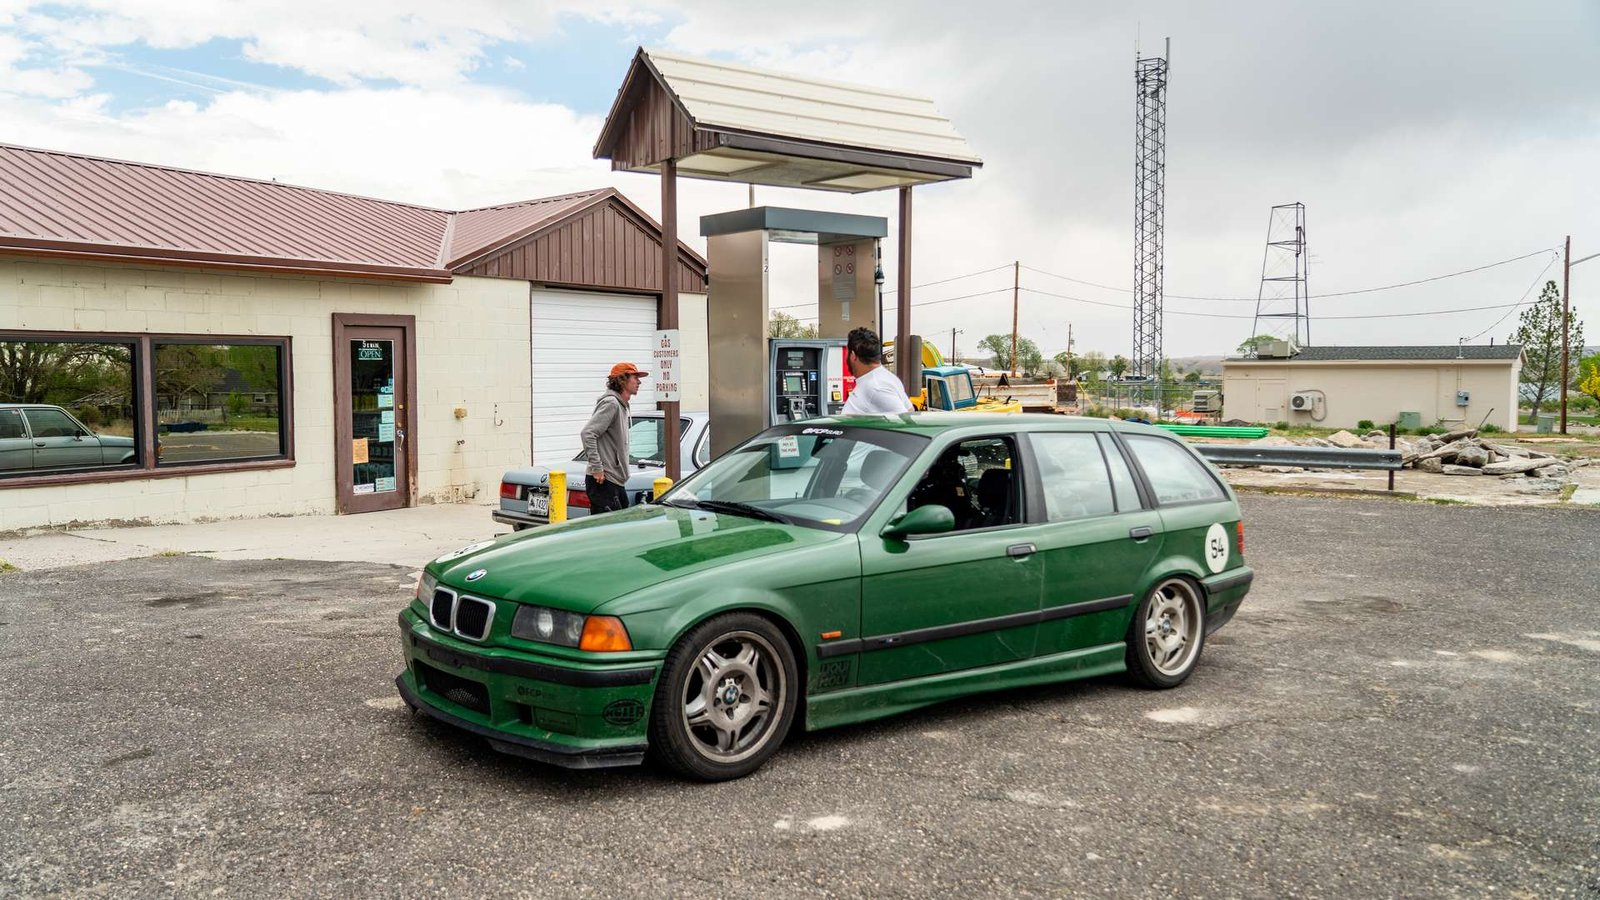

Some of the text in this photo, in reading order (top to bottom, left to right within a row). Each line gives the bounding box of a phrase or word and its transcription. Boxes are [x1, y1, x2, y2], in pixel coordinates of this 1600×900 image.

[660, 339, 671, 348] GAS
[360, 350, 381, 358] OPEN
[653, 350, 679, 358] CUSTOMERS
[660, 360, 673, 369] ONLY
[662, 371, 670, 380] NO
[656, 383, 678, 392] PARKING
